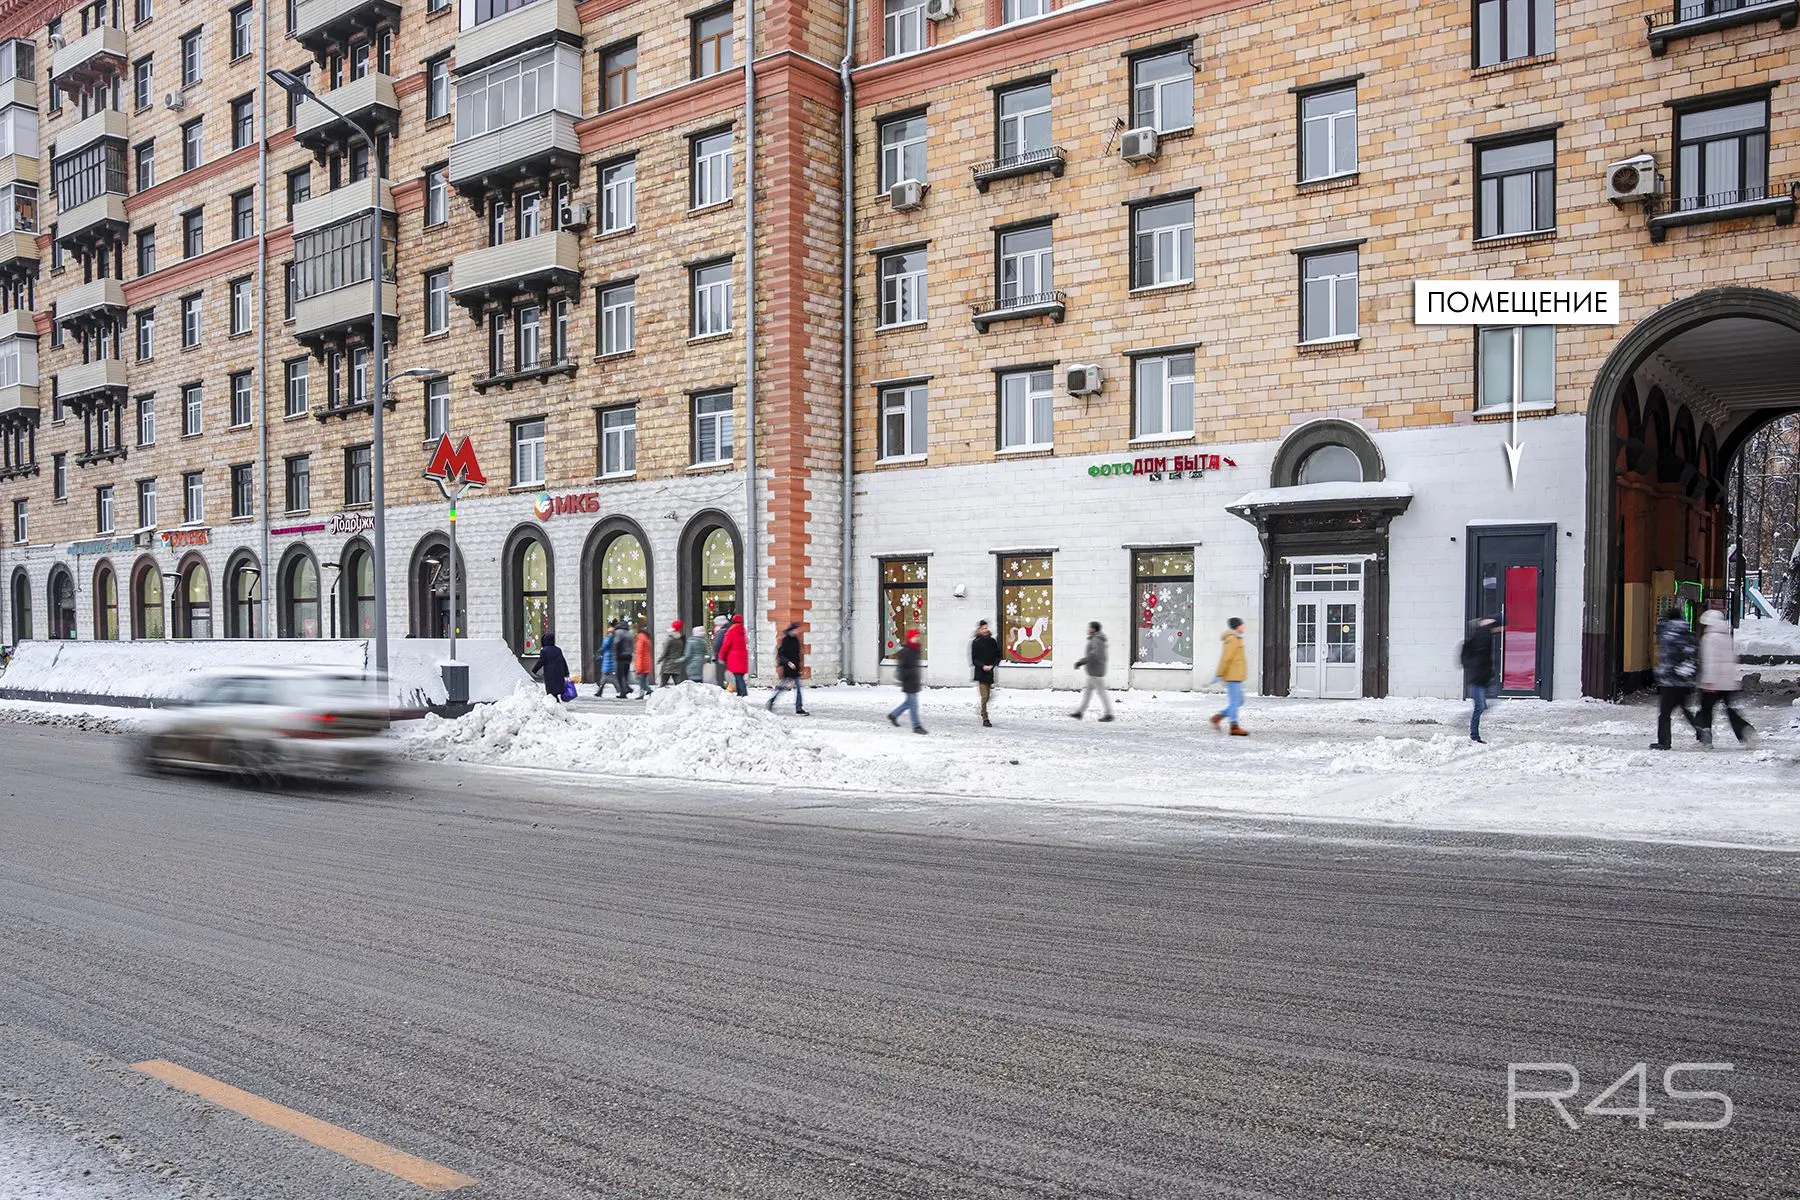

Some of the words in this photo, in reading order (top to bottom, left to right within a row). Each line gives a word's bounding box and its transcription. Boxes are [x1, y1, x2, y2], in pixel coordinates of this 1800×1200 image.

[424, 432, 488, 484] М
[1174, 454, 1221, 471] БЫТА
[555, 492, 600, 515] МКБ
[329, 512, 376, 535] Подружк
